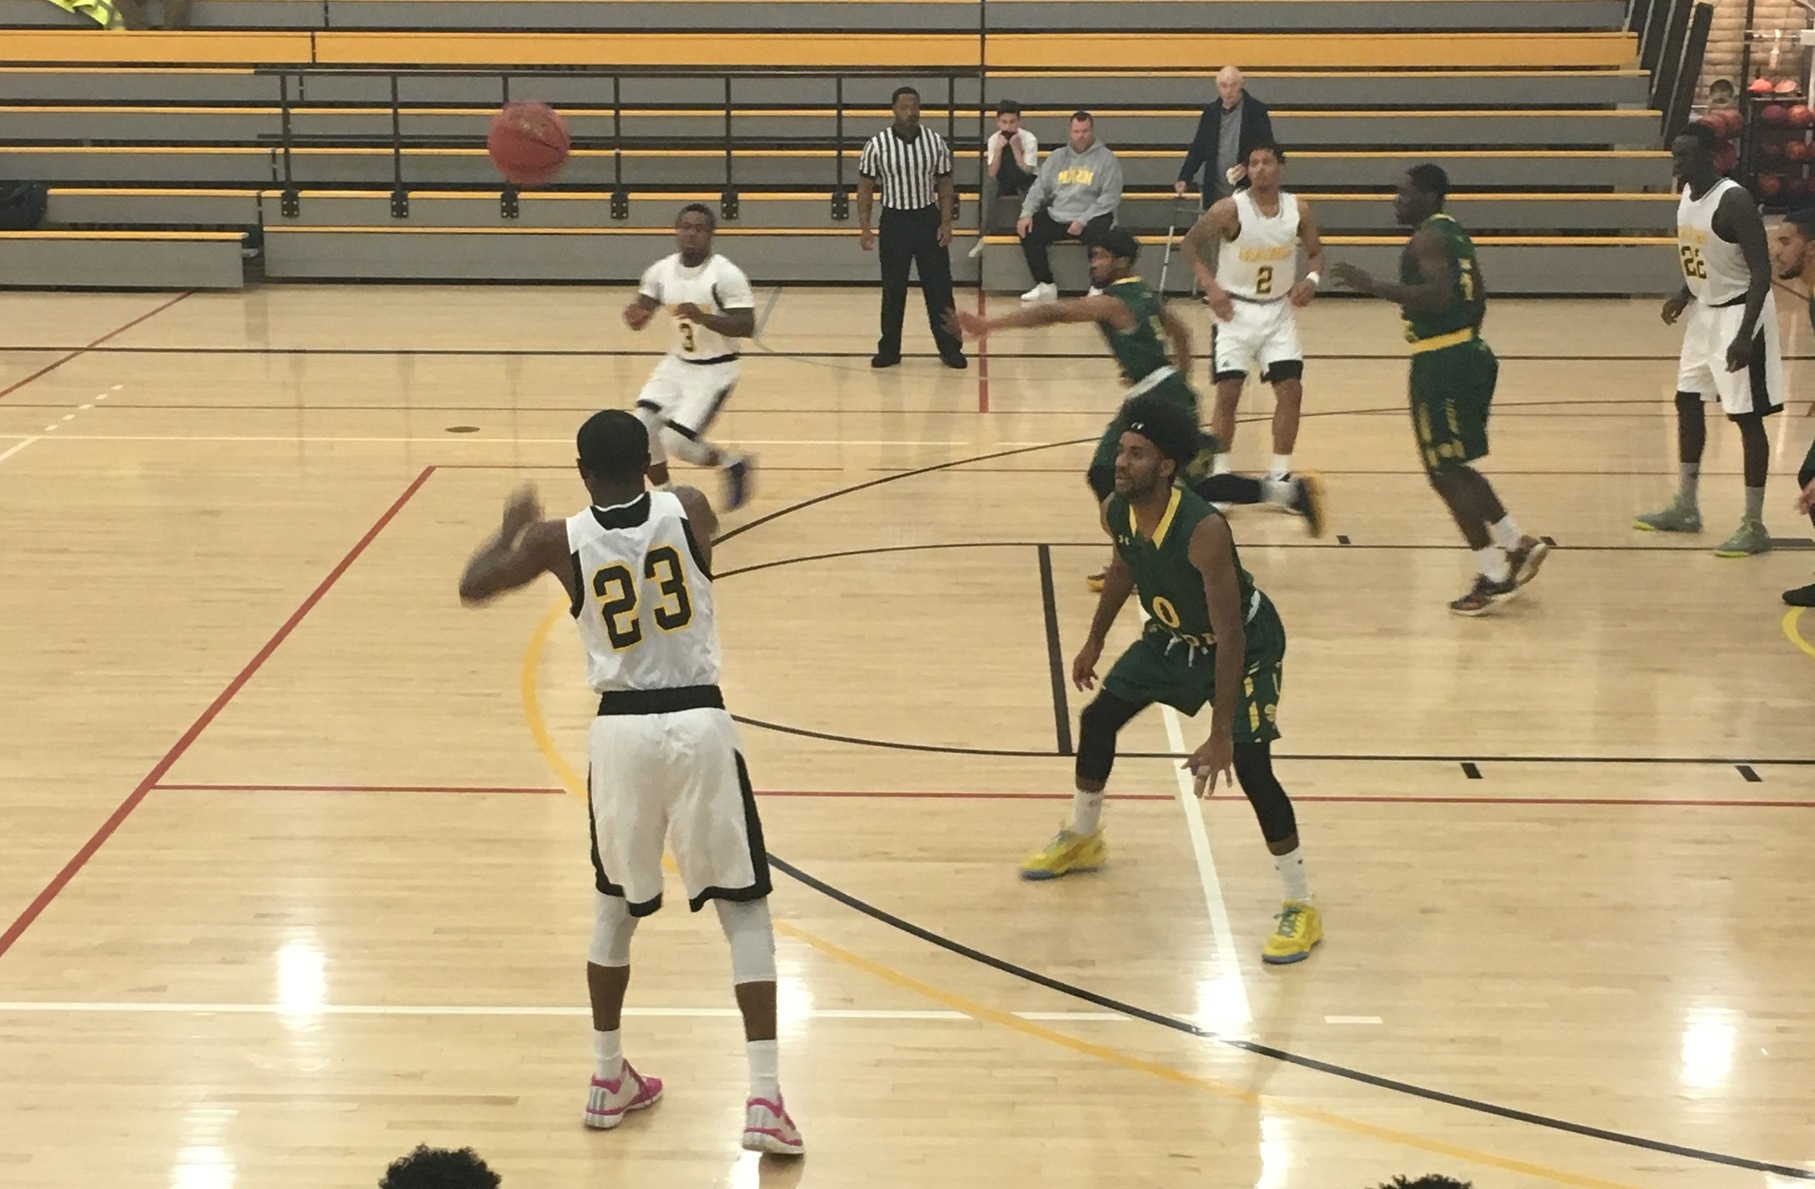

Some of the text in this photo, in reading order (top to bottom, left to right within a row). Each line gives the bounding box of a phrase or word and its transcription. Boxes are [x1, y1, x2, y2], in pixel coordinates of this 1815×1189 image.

[1256, 266, 1274, 295] 2
[679, 322, 697, 353] 3
[591, 544, 695, 652] 23
[1152, 595, 1181, 629] 0
